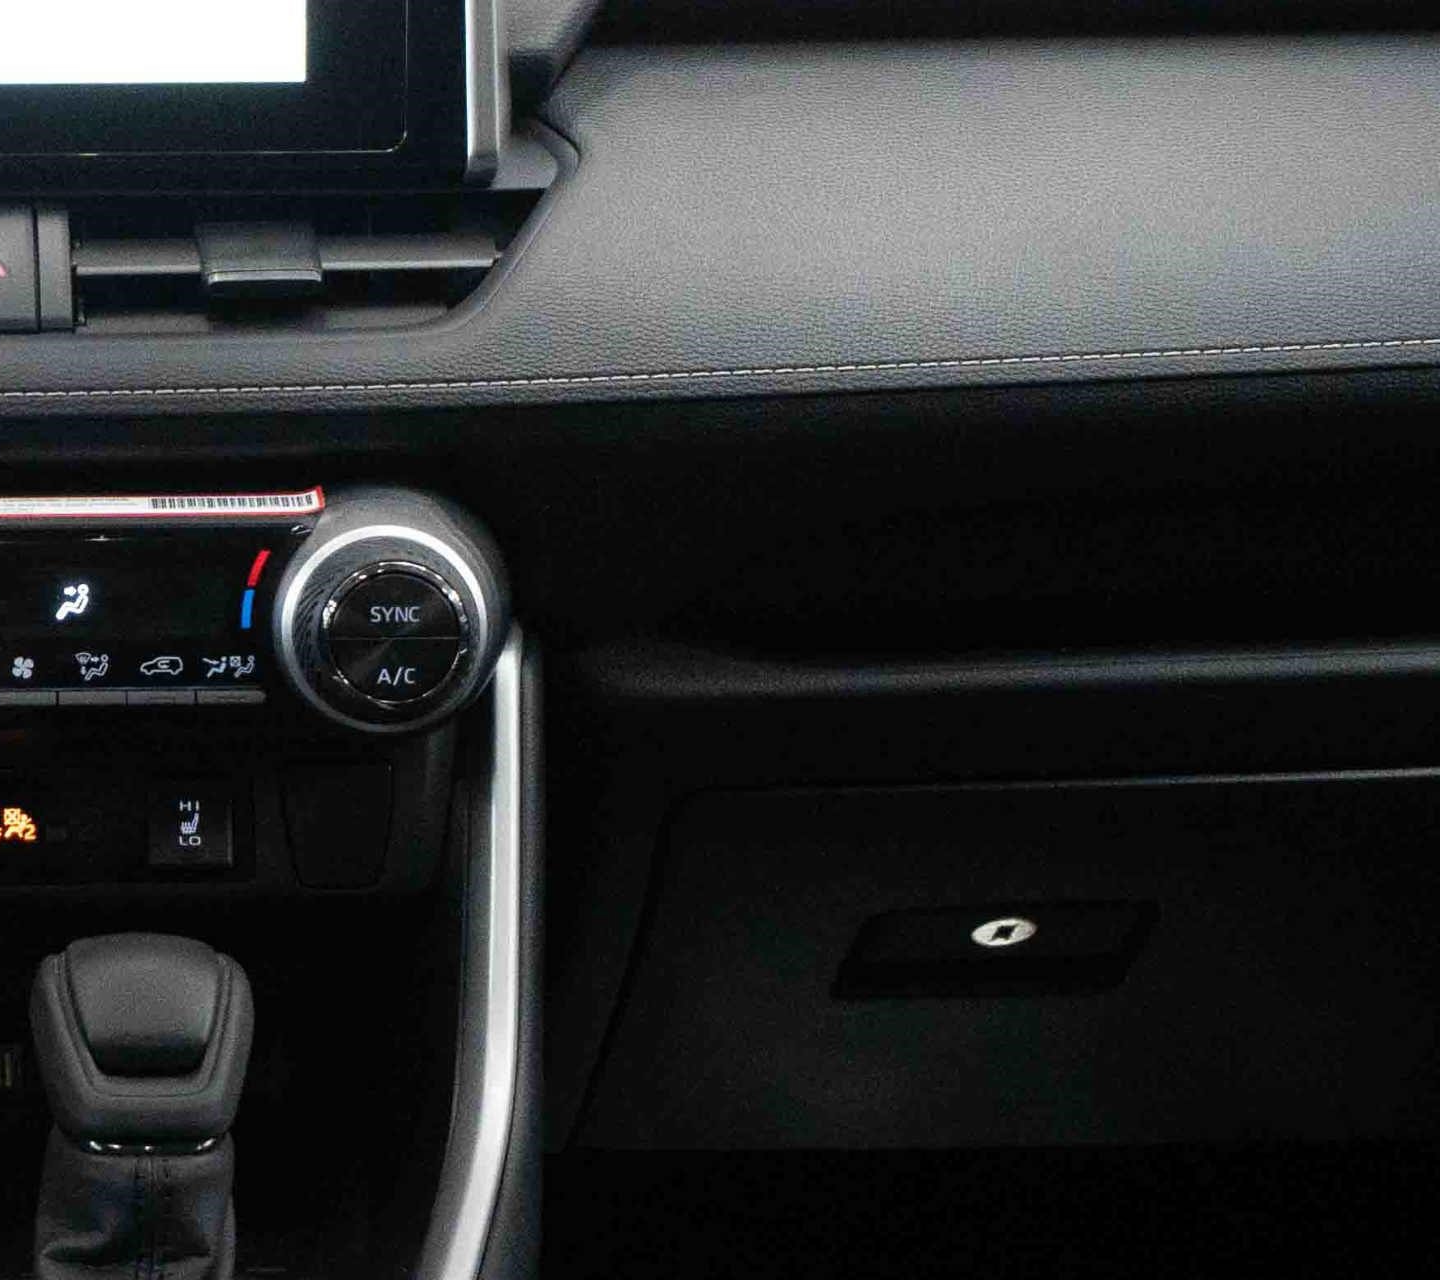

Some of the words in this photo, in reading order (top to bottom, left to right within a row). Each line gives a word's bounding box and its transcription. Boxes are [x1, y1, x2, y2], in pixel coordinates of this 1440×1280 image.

[370, 606, 420, 623] SYNC
[377, 666, 416, 686] A/C
[179, 801, 200, 812] HI
[179, 835, 201, 846] LO
